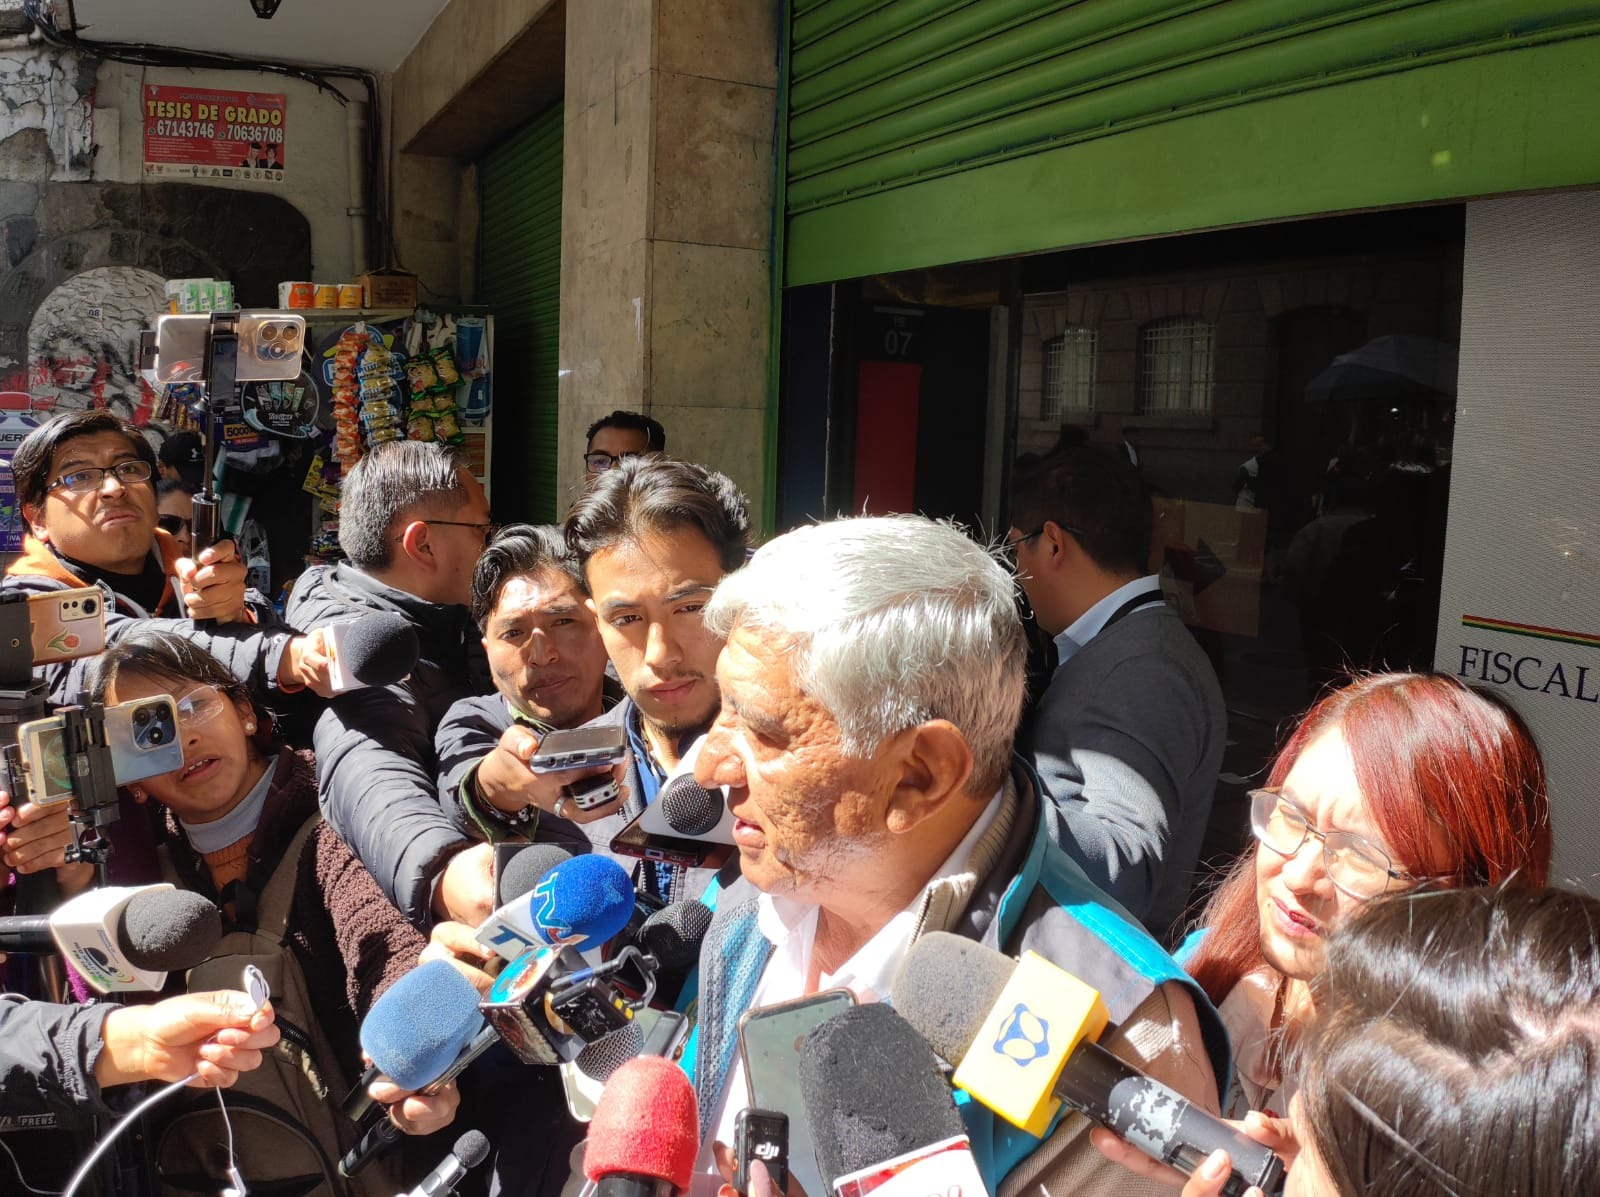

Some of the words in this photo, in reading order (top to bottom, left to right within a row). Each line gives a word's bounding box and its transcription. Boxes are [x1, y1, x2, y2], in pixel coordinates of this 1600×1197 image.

[147, 101, 192, 120] TESIS
[198, 104, 219, 121] DE
[225, 106, 282, 126] GRADO
[157, 119, 215, 139] 67143746
[227, 124, 283, 144] 70636708
[885, 329, 913, 356] 07
[1457, 645, 1599, 703] FISCAL
